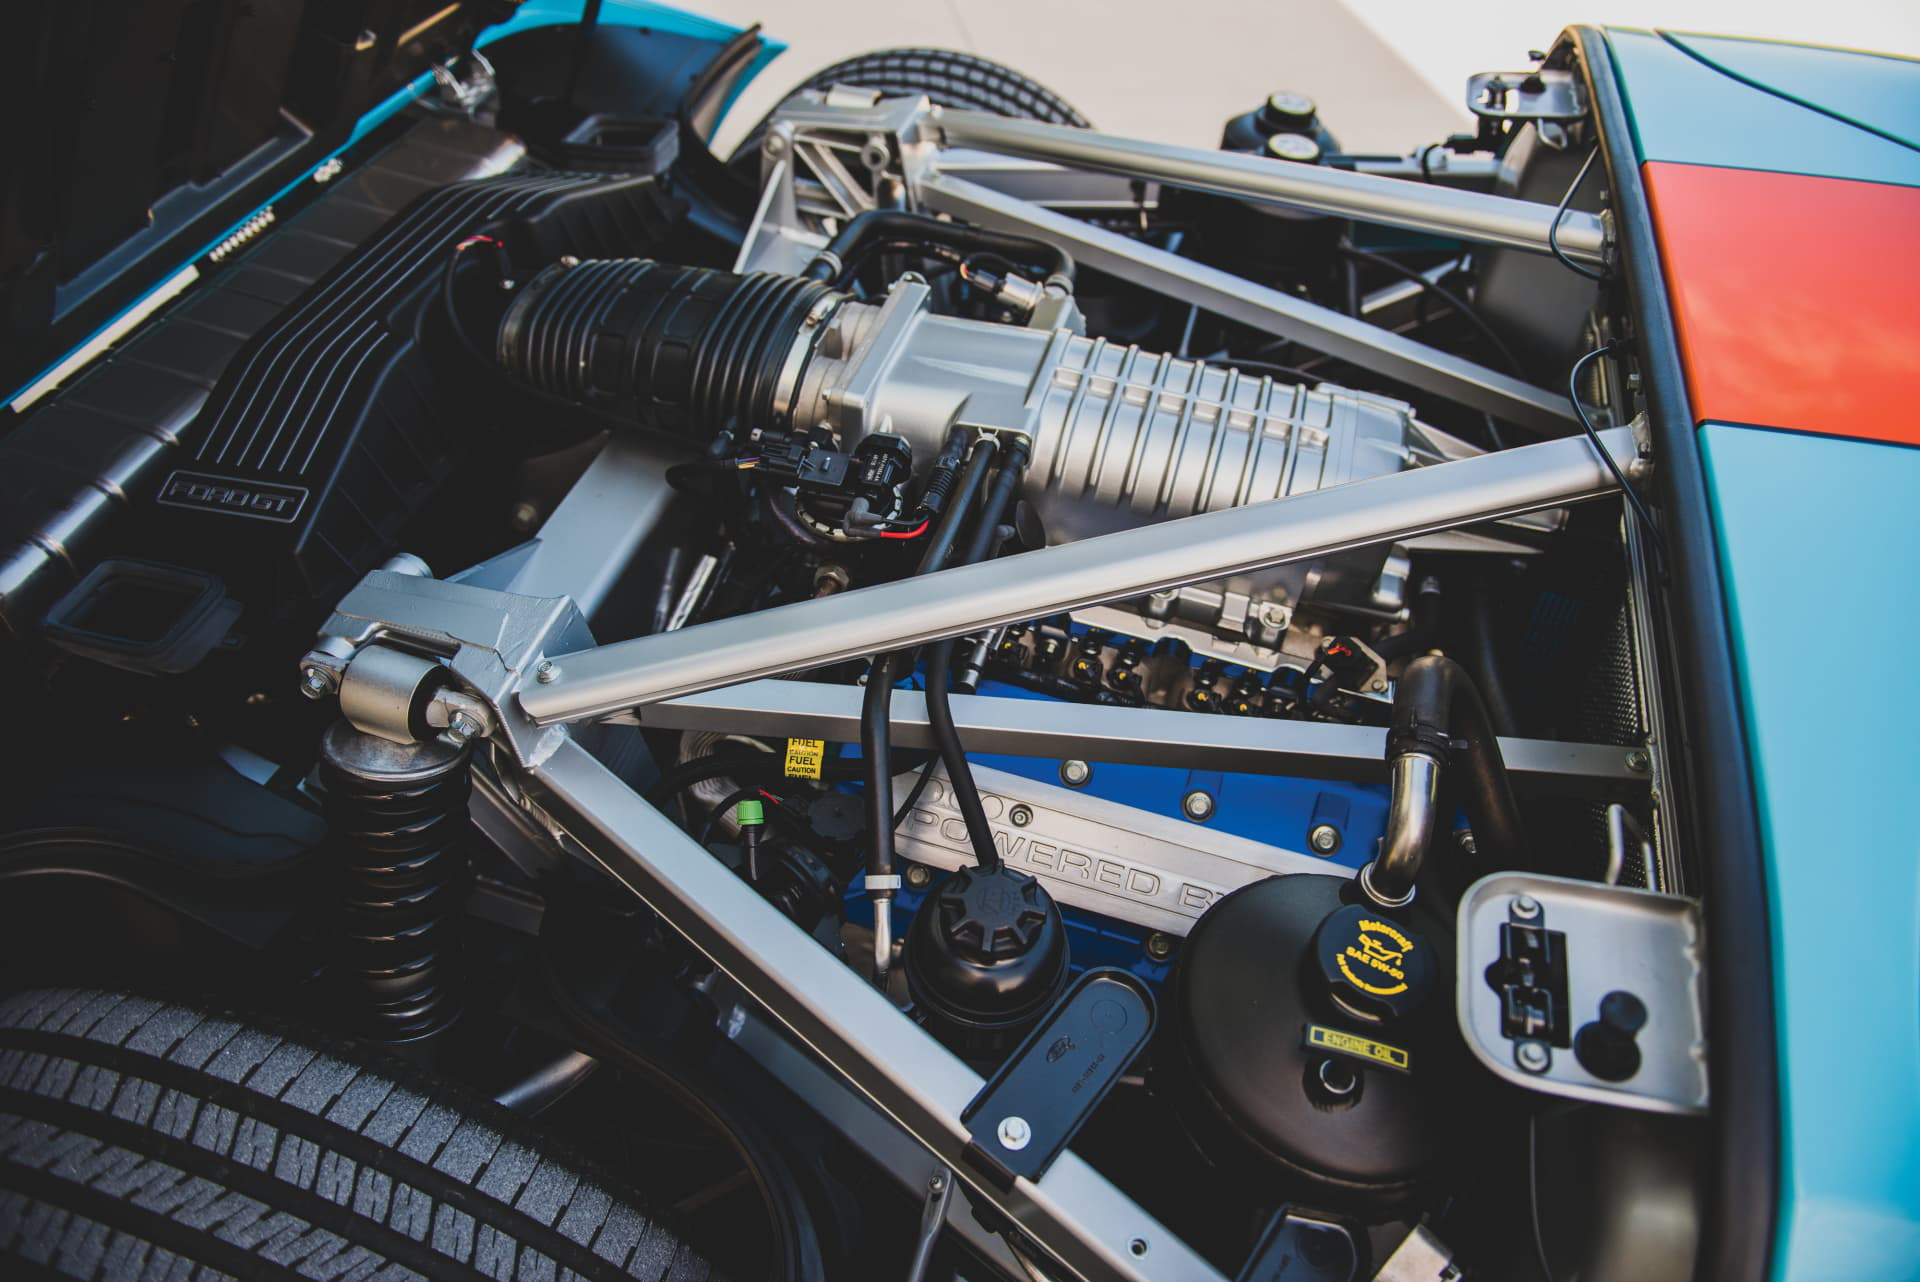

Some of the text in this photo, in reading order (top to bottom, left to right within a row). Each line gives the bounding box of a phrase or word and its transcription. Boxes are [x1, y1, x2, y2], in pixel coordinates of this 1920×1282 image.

[168, 481, 296, 512] FORD GT
[787, 766, 816, 774] CAUTION
[789, 755, 816, 766] FUEL
[1179, 882, 1225, 910] B
[1346, 946, 1370, 964] SAE
[1326, 1031, 1397, 1063] ENGINE OIL
